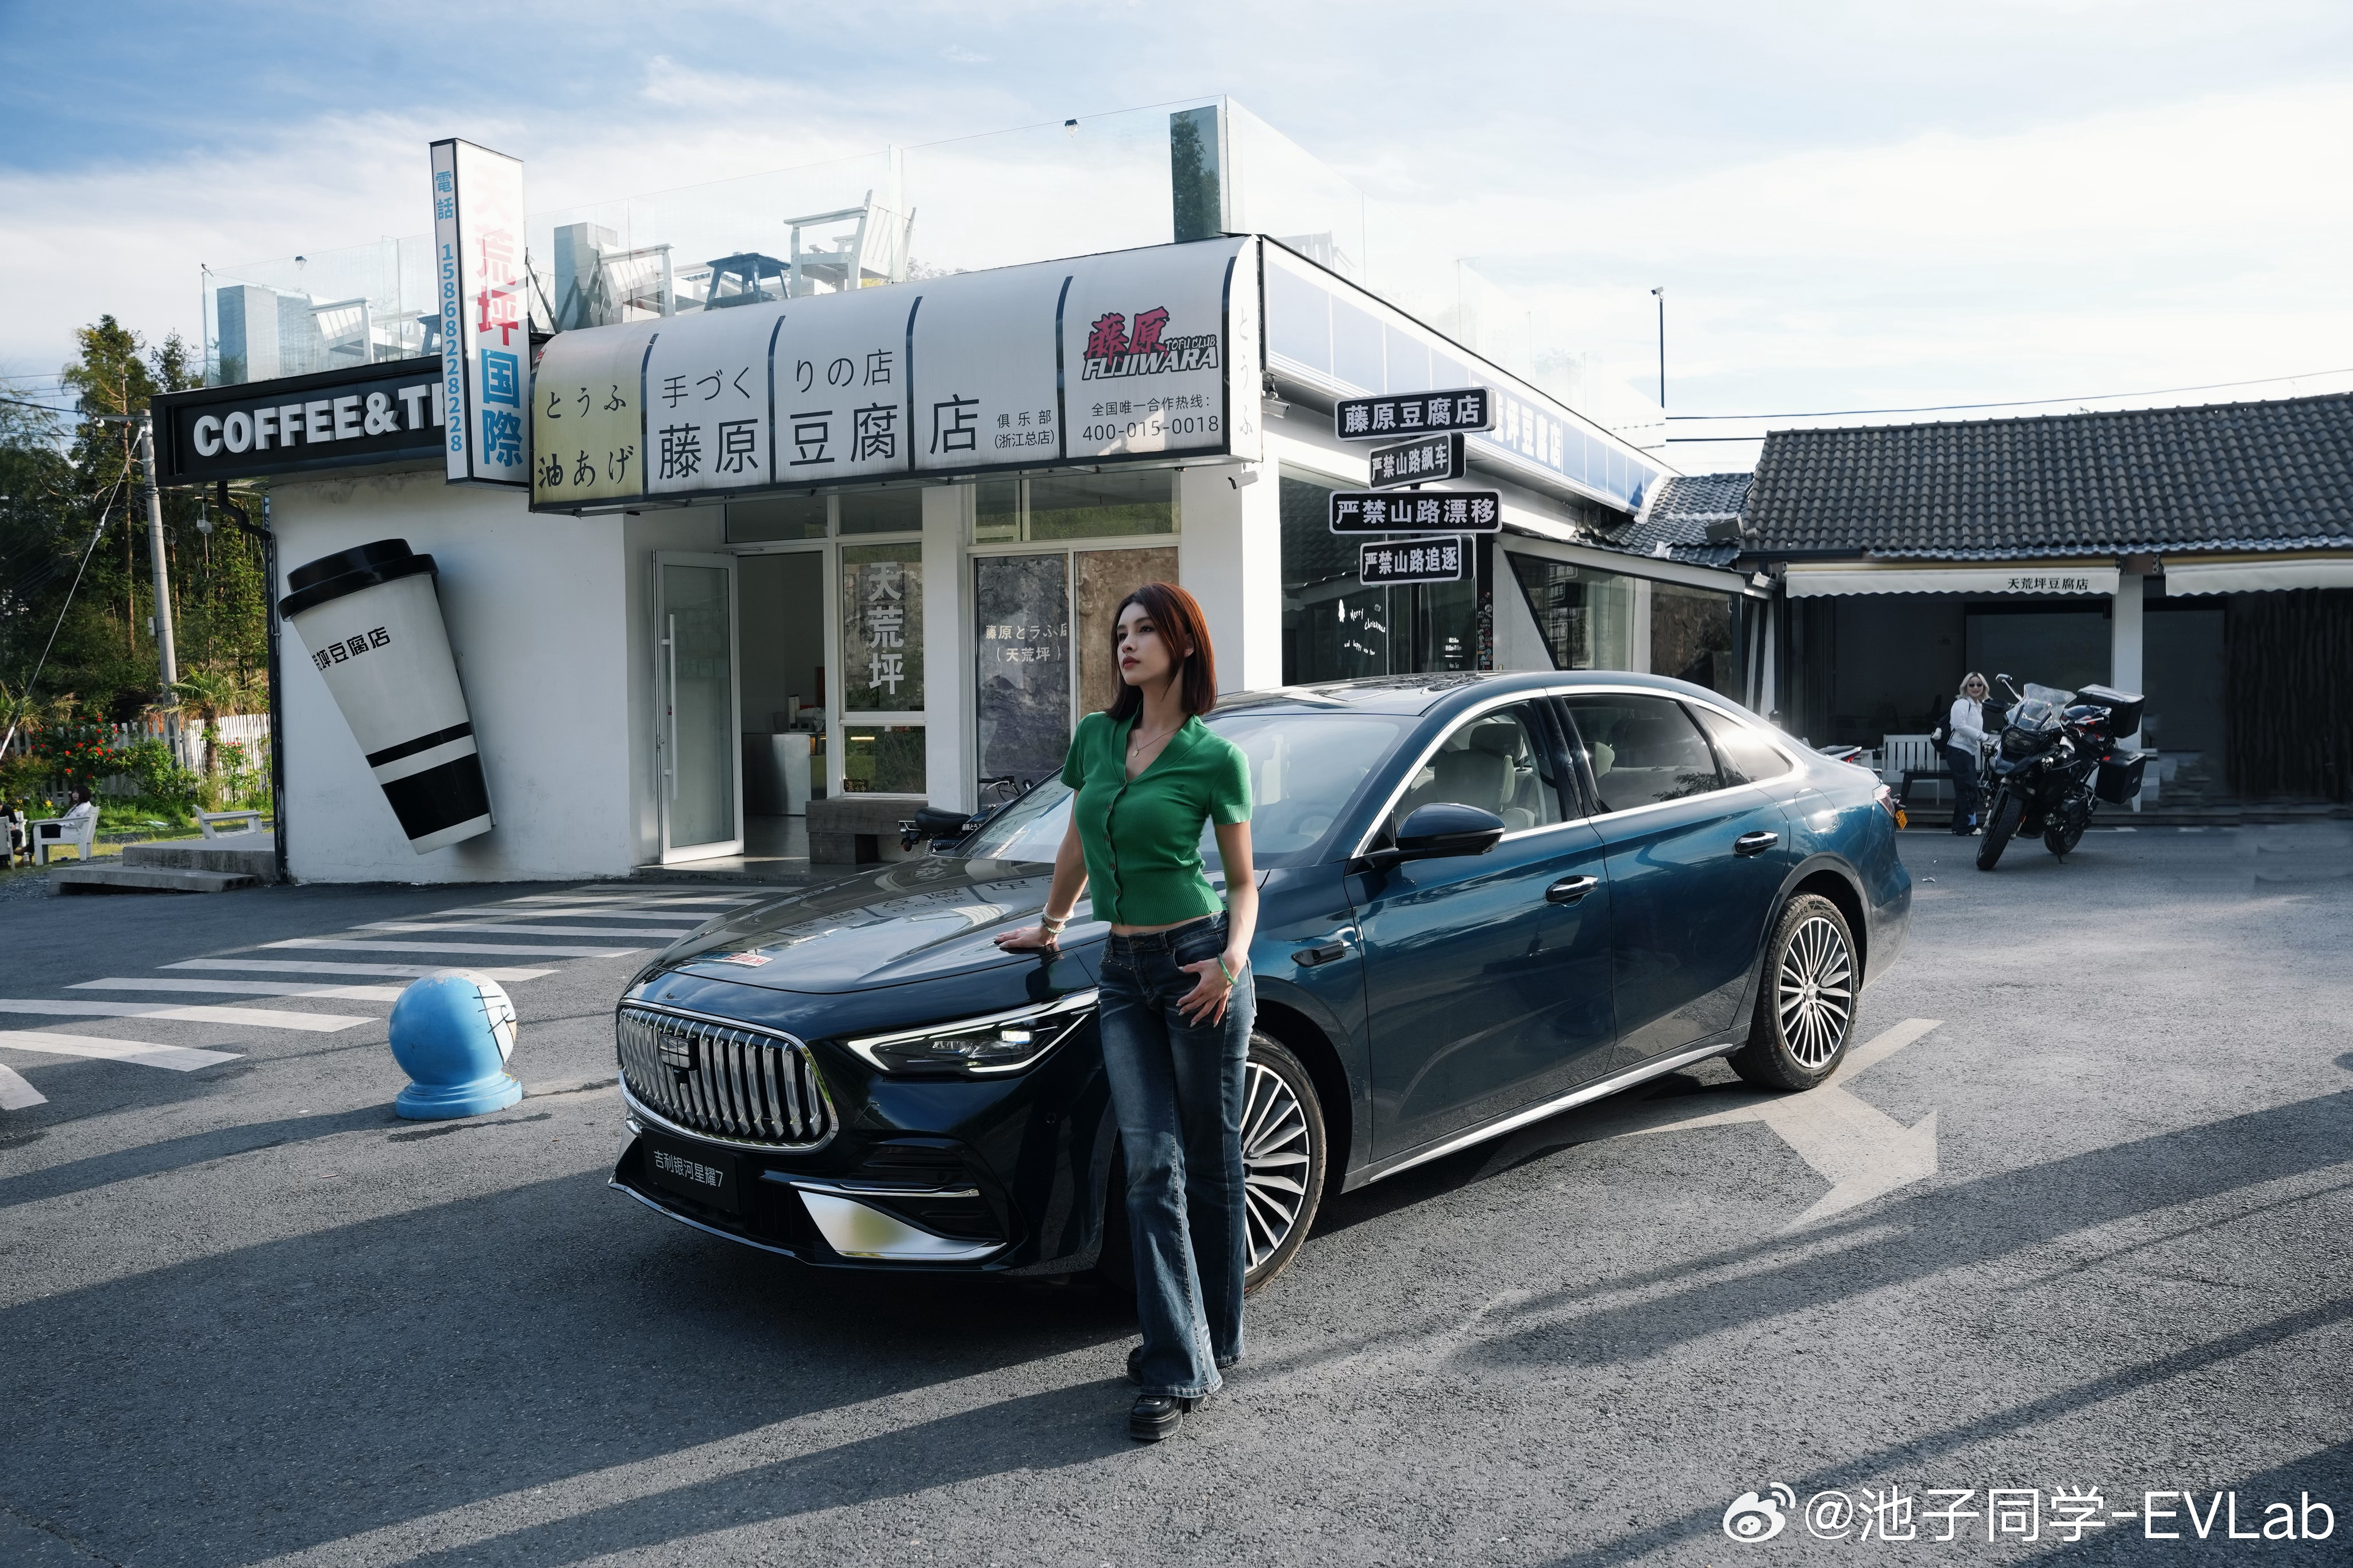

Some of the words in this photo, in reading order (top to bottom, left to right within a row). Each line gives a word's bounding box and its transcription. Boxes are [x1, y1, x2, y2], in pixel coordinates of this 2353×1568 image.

[435, 171, 453, 220] 電話
[442, 243, 462, 452] 15868228228
[1083, 306, 1170, 366] 藤原
[1165, 337, 1191, 351] TOFU
[1191, 334, 1218, 349] CLUB
[1082, 345, 1218, 381] FUJIWARA
[1239, 306, 1253, 436] とうふ
[546, 385, 627, 419] とうふ
[1344, 395, 1480, 433] 藤原豆腐店
[994, 430, 1055, 450] (浙江总店)
[1083, 416, 1218, 441] 400-015-0018
[538, 446, 634, 489] 油あげ
[1371, 443, 1448, 481] 严禁山路飙车
[1336, 498, 1496, 525] 严禁山路漂移
[1364, 546, 1457, 576] 严禁山路追逐
[2007, 577, 2089, 590] 天荒坪豆腐店
[867, 561, 905, 695] 天荒坪
[1350, 608, 1364, 621] Merry
[653, 1149, 723, 1187] 吉利银河星耀7
